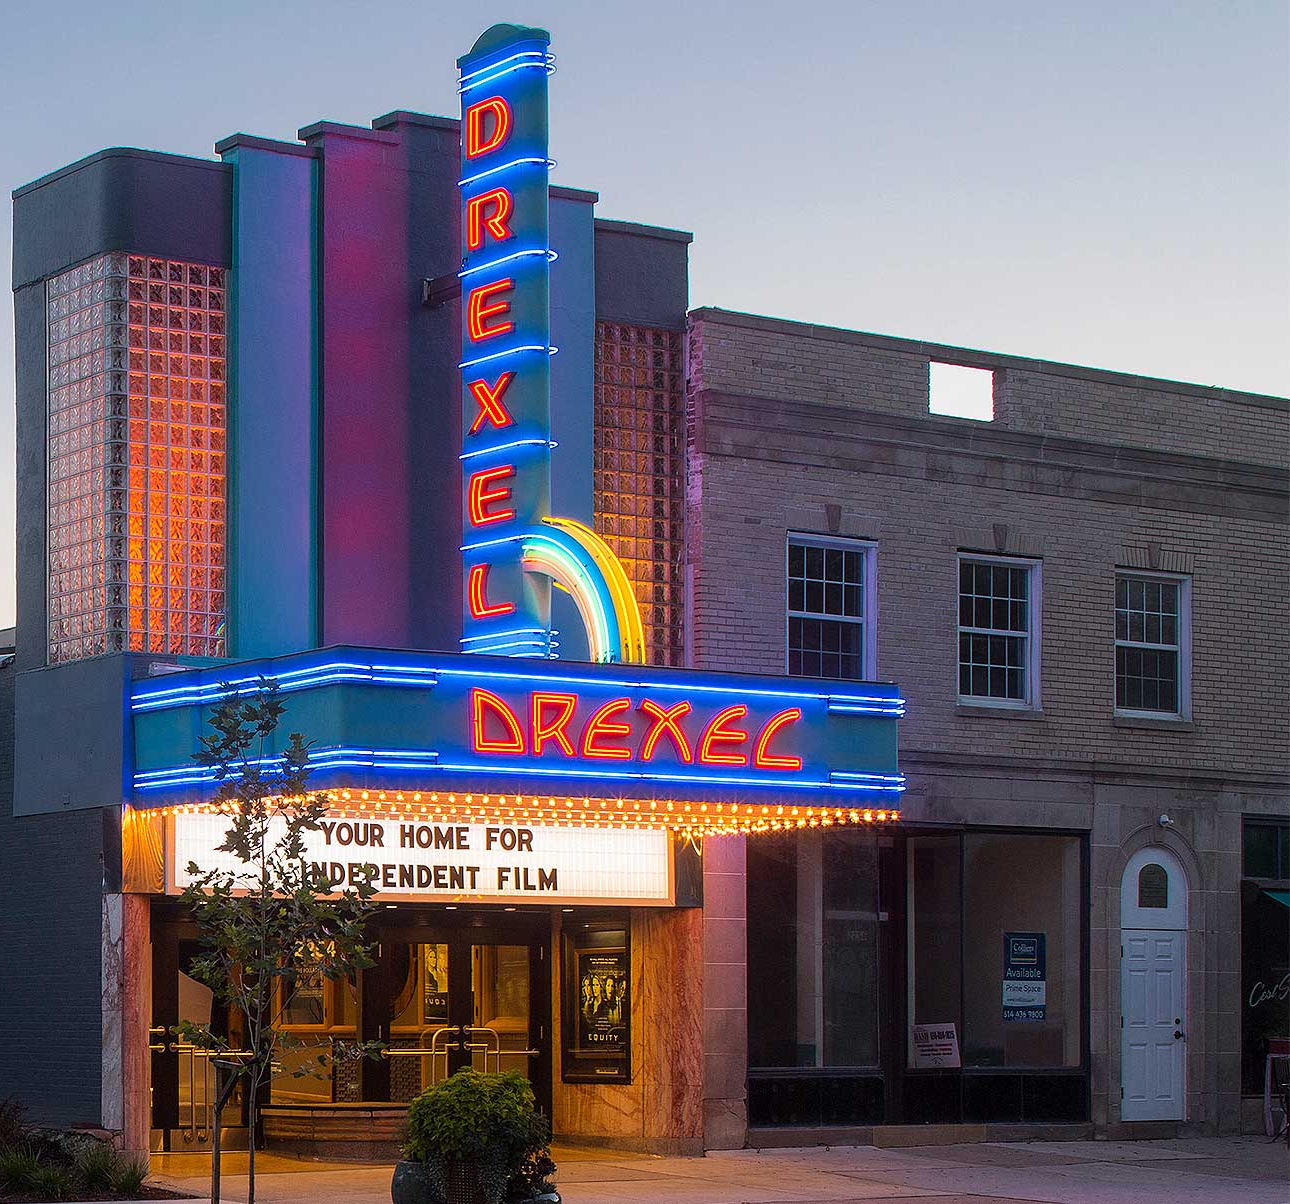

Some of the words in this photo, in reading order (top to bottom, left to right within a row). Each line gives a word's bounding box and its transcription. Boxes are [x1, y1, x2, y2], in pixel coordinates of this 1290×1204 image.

[466, 95, 517, 620] DREXEL
[471, 686, 802, 771] DREXEL
[320, 822, 385, 848] YOUR
[400, 824, 470, 850] HOME
[486, 827, 534, 852] FOR
[497, 867, 558, 891] FILM
[1005, 967, 1042, 978] Available
[1006, 984, 1023, 993] Prime
[1023, 984, 1041, 994] Space
[588, 1033, 619, 1042] EQUITY
